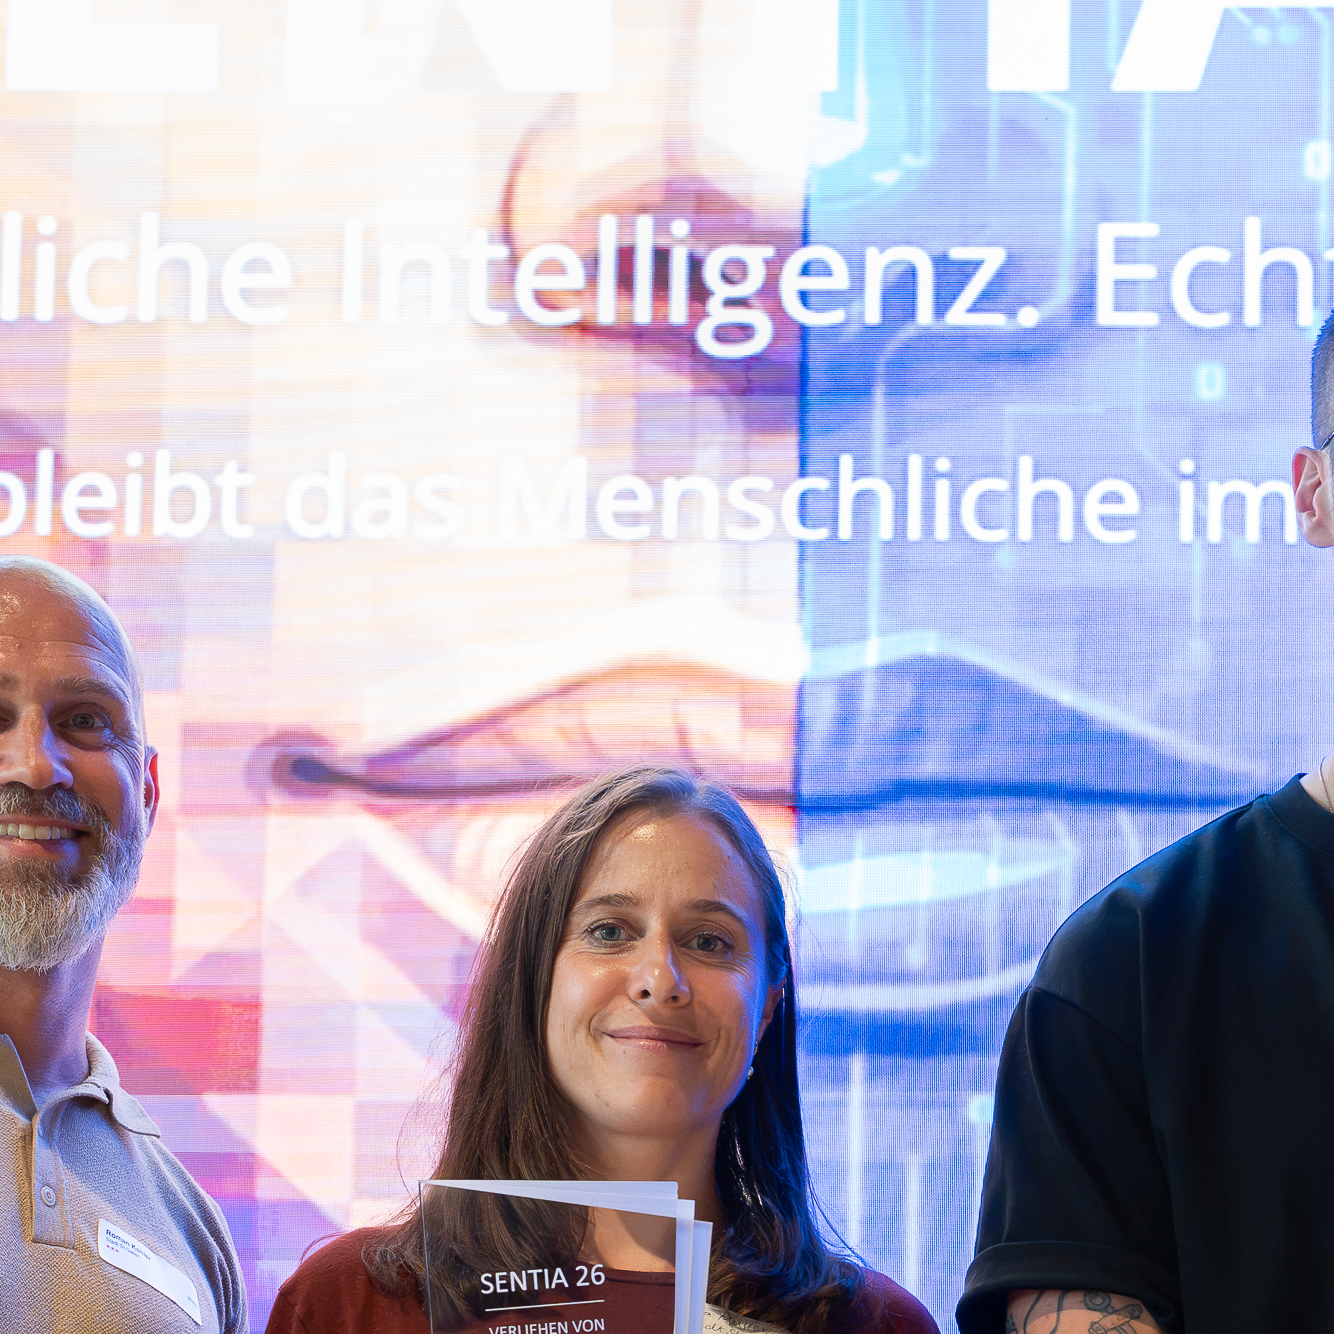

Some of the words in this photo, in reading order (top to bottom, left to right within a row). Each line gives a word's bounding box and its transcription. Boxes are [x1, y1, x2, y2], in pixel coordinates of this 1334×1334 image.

[341, 213, 1041, 360] Intelligenz.
[282, 450, 464, 541] das
[499, 452, 1141, 545] Menschliche
[1179, 458, 1298, 544] im
[480, 1267, 569, 1295] SENTIA
[575, 1264, 606, 1287] 26
[572, 1318, 606, 1334] VON
